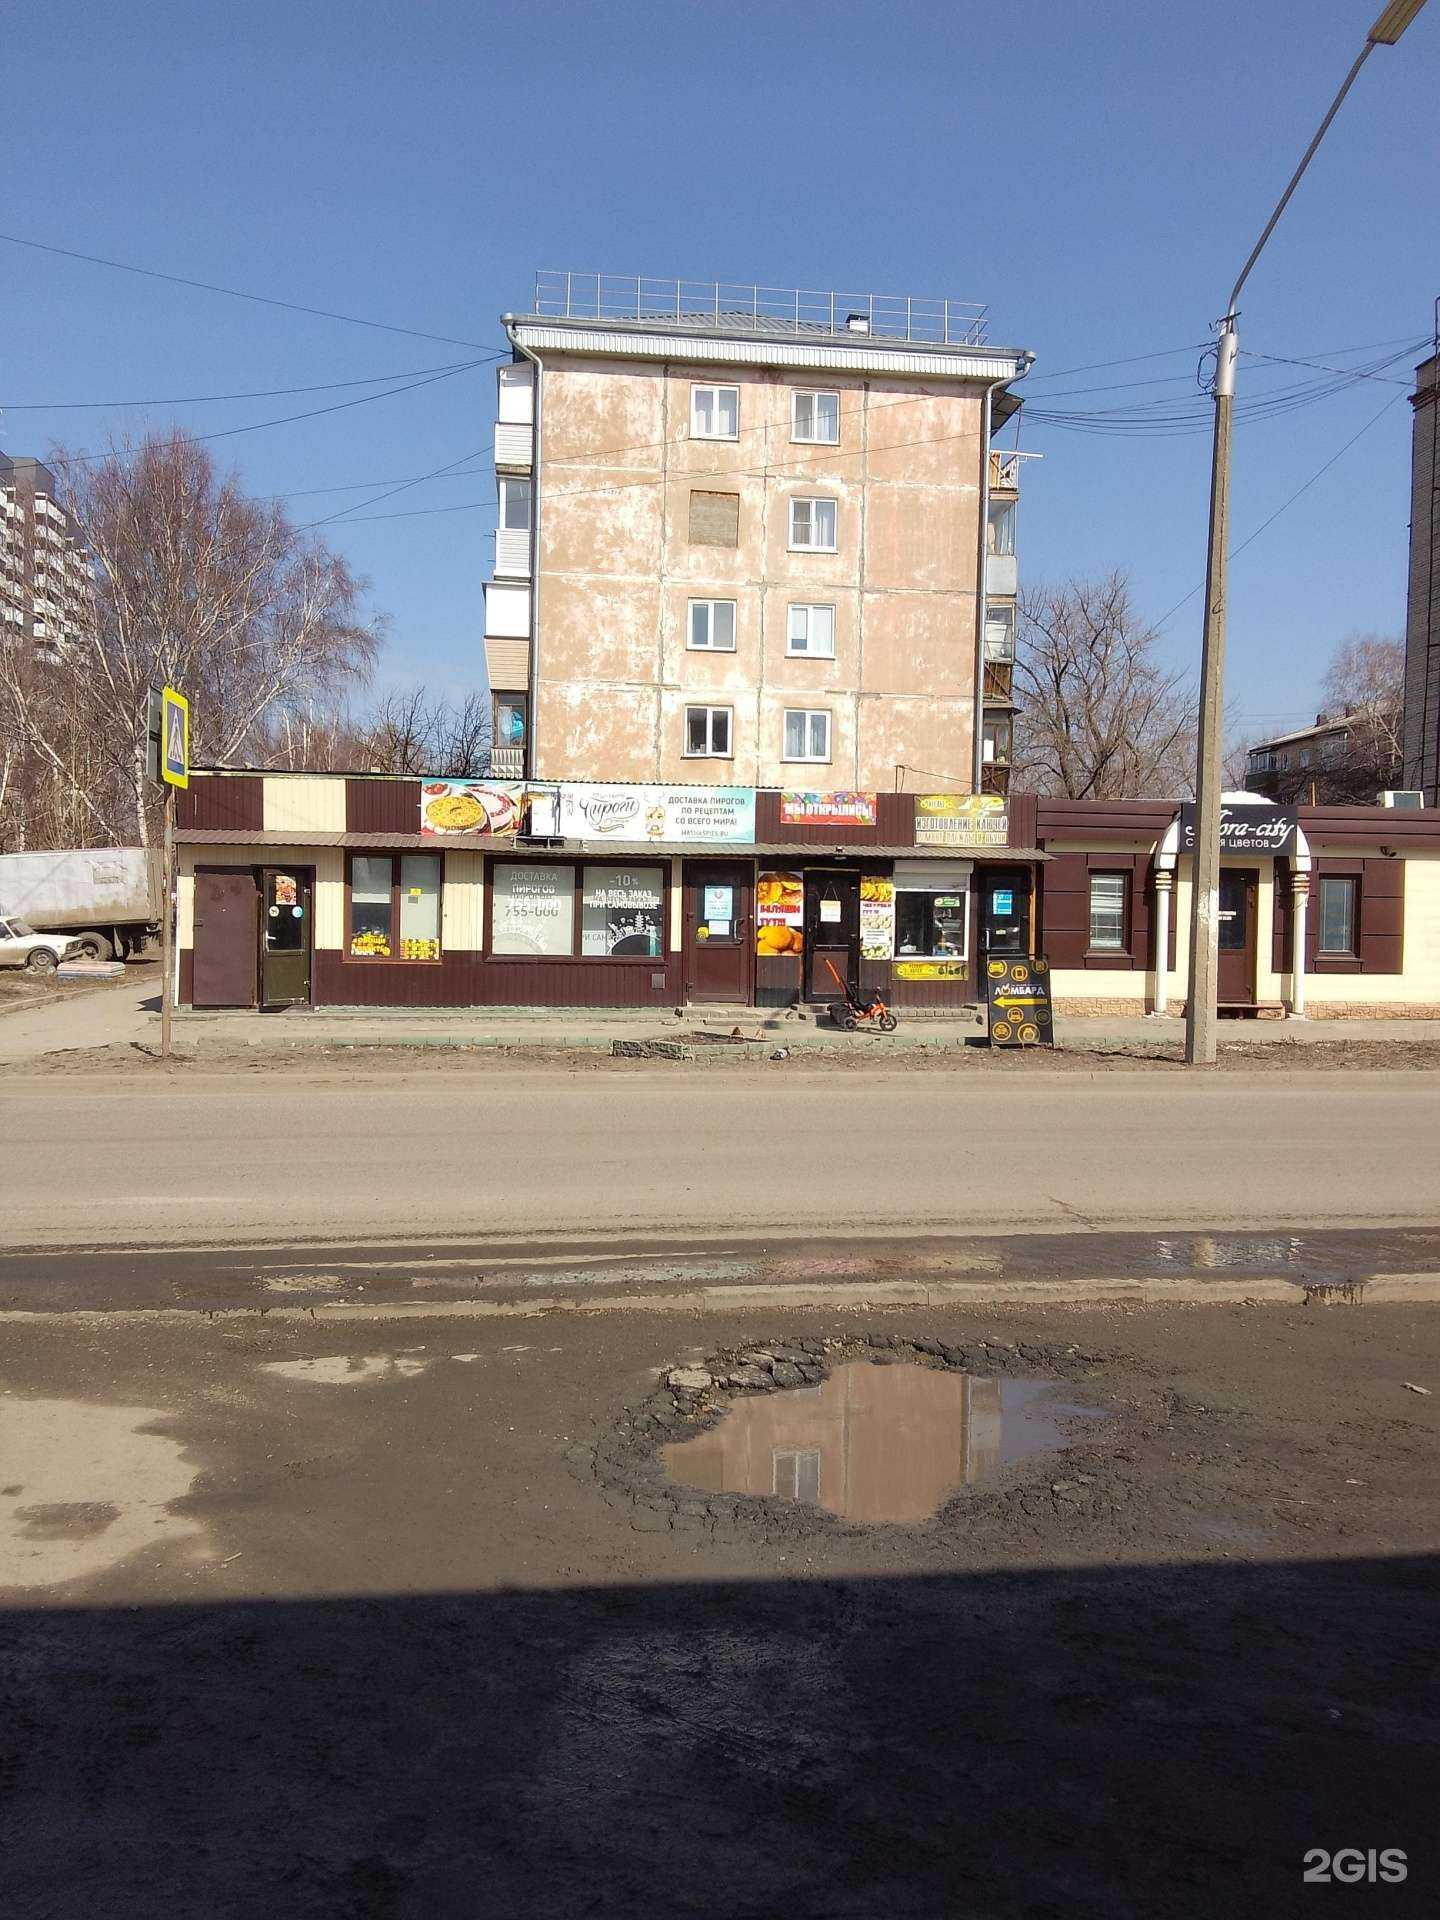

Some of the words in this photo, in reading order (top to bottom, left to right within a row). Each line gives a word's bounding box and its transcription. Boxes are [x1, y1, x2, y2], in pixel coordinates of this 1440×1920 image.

[668, 796, 708, 805] ДОСТАВКА
[710, 797, 745, 805] ПИРОГОВ
[681, 807, 692, 815] ПО
[694, 807, 734, 816] РЕЦЕПТАМ
[675, 817, 686, 825] СО
[688, 817, 711, 825] ВСЕГО
[916, 818, 971, 830] ИЗГОТОВЛЕНИЕ
[976, 817, 1007, 830] КЛЮЧЕЙ
[511, 872, 558, 881] ДОСТАВКА
[512, 884, 555, 894] ПИРОГОВ
[595, 889, 607, 897] НА
[608, 890, 627, 898] ВЕСЬ
[628, 890, 652, 898] ЗАКАЗ
[589, 901, 606, 909] ПРИ
[607, 901, 658, 910] САМОВЫВОЗЕ
[994, 984, 1045, 996] ЛОМБАРД
